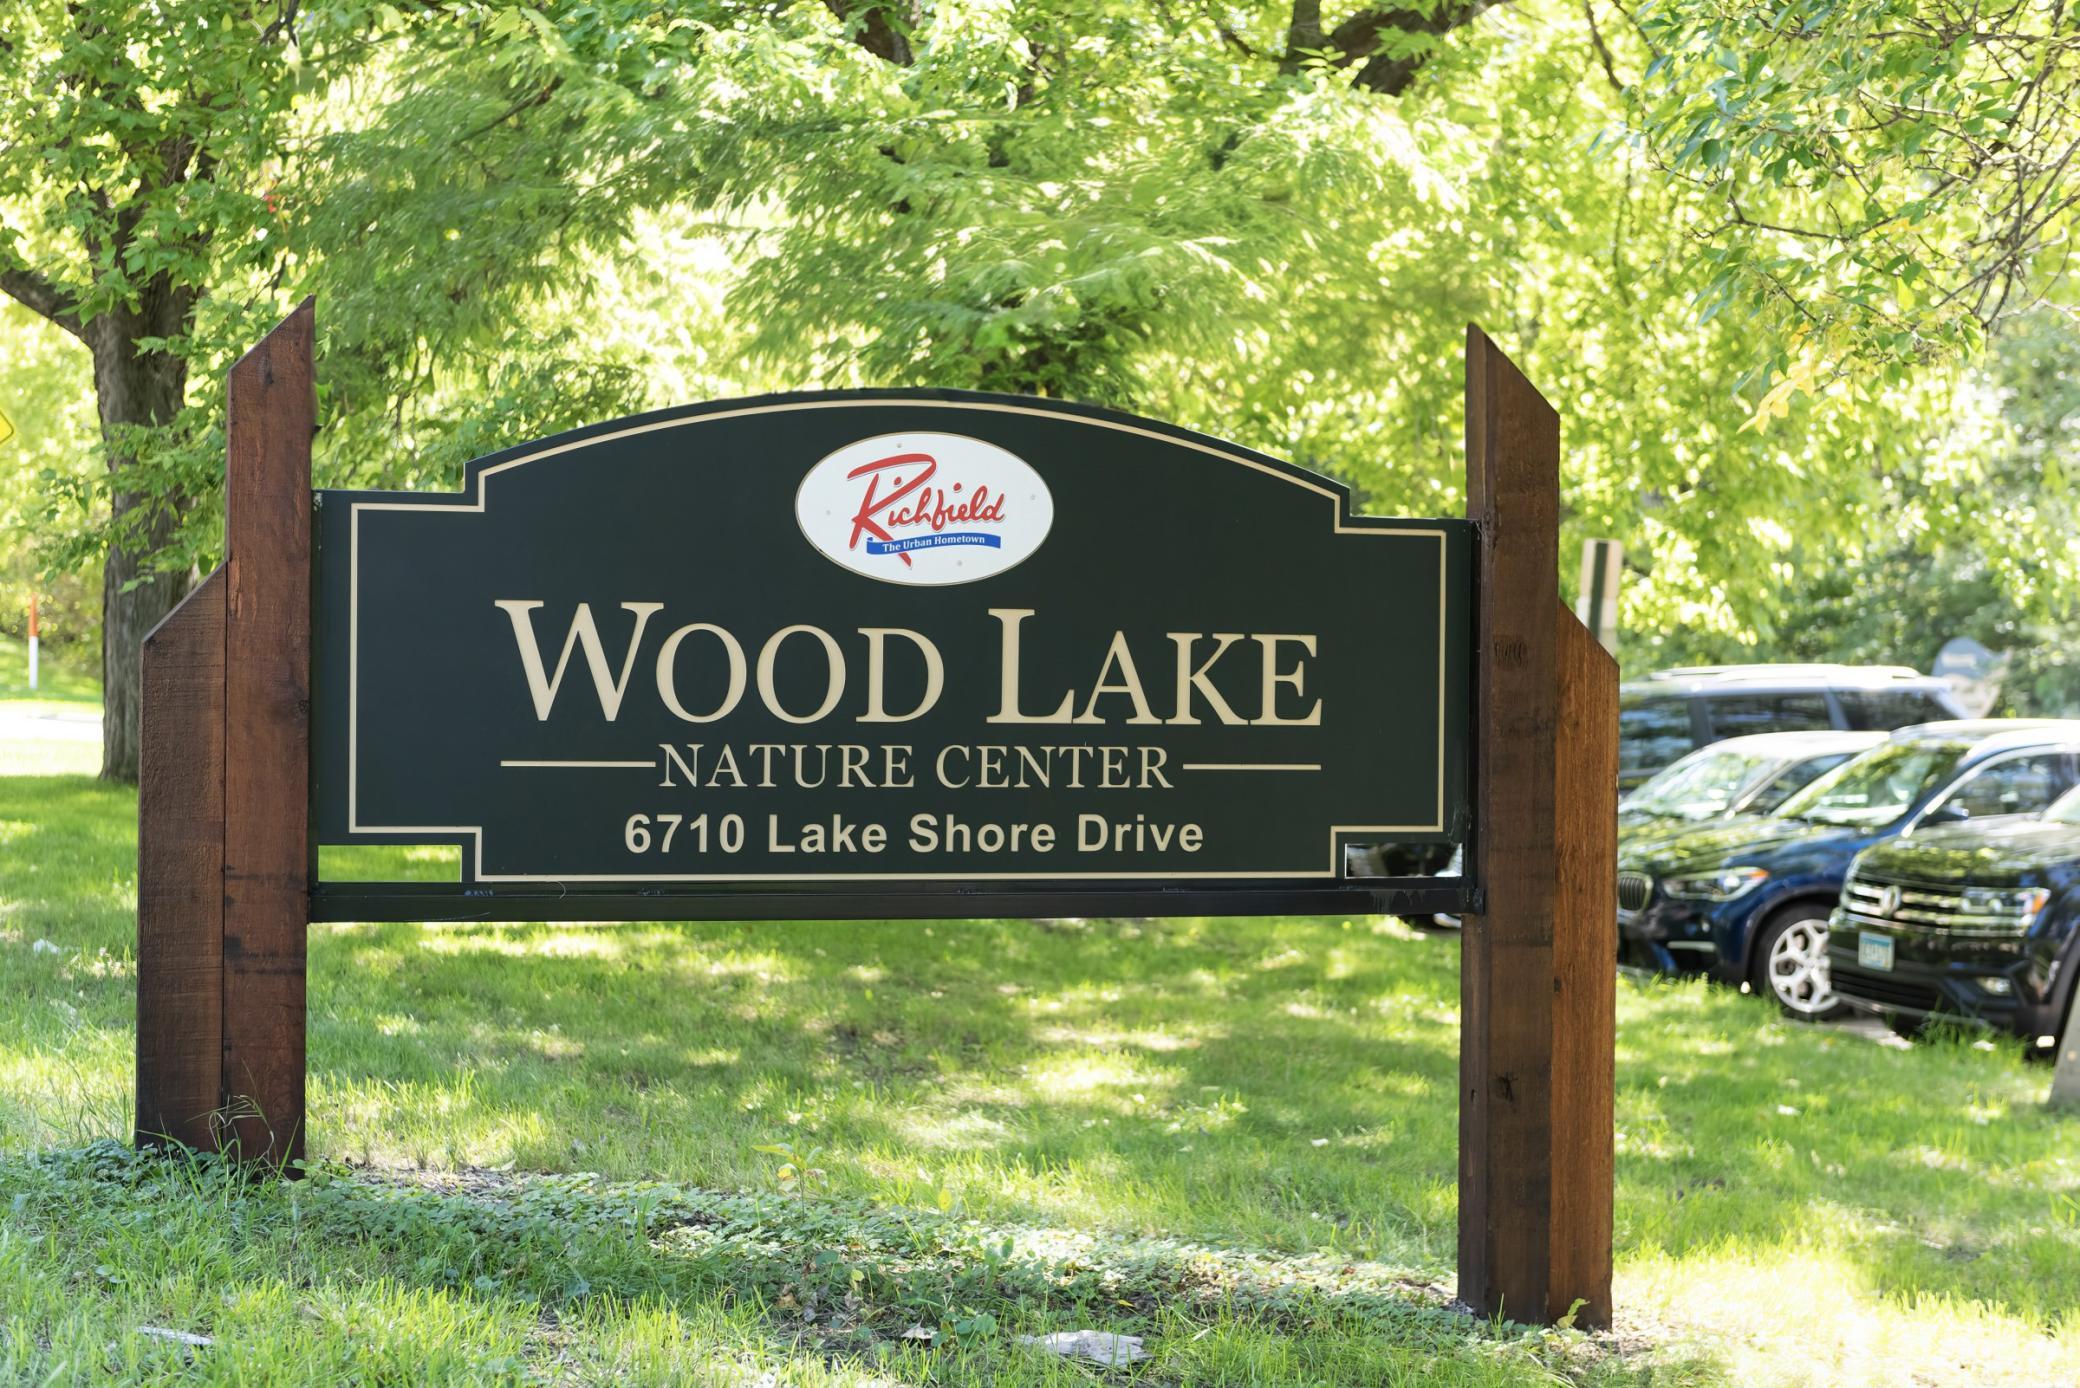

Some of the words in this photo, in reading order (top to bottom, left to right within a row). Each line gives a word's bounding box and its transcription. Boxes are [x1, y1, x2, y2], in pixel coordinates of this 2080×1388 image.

[847, 453, 1005, 567] Richfield
[882, 543, 901, 553] The
[903, 537, 932, 549] Urban
[934, 534, 985, 546] Hometown
[494, 599, 945, 725] WOOD
[986, 608, 1322, 726] LAKE
[659, 743, 914, 788] NATURE
[936, 744, 1175, 789] CENTER
[625, 813, 745, 854] 6710
[768, 814, 887, 853] Lake
[908, 813, 1056, 853] Shore
[1077, 814, 1204, 853] Drive
